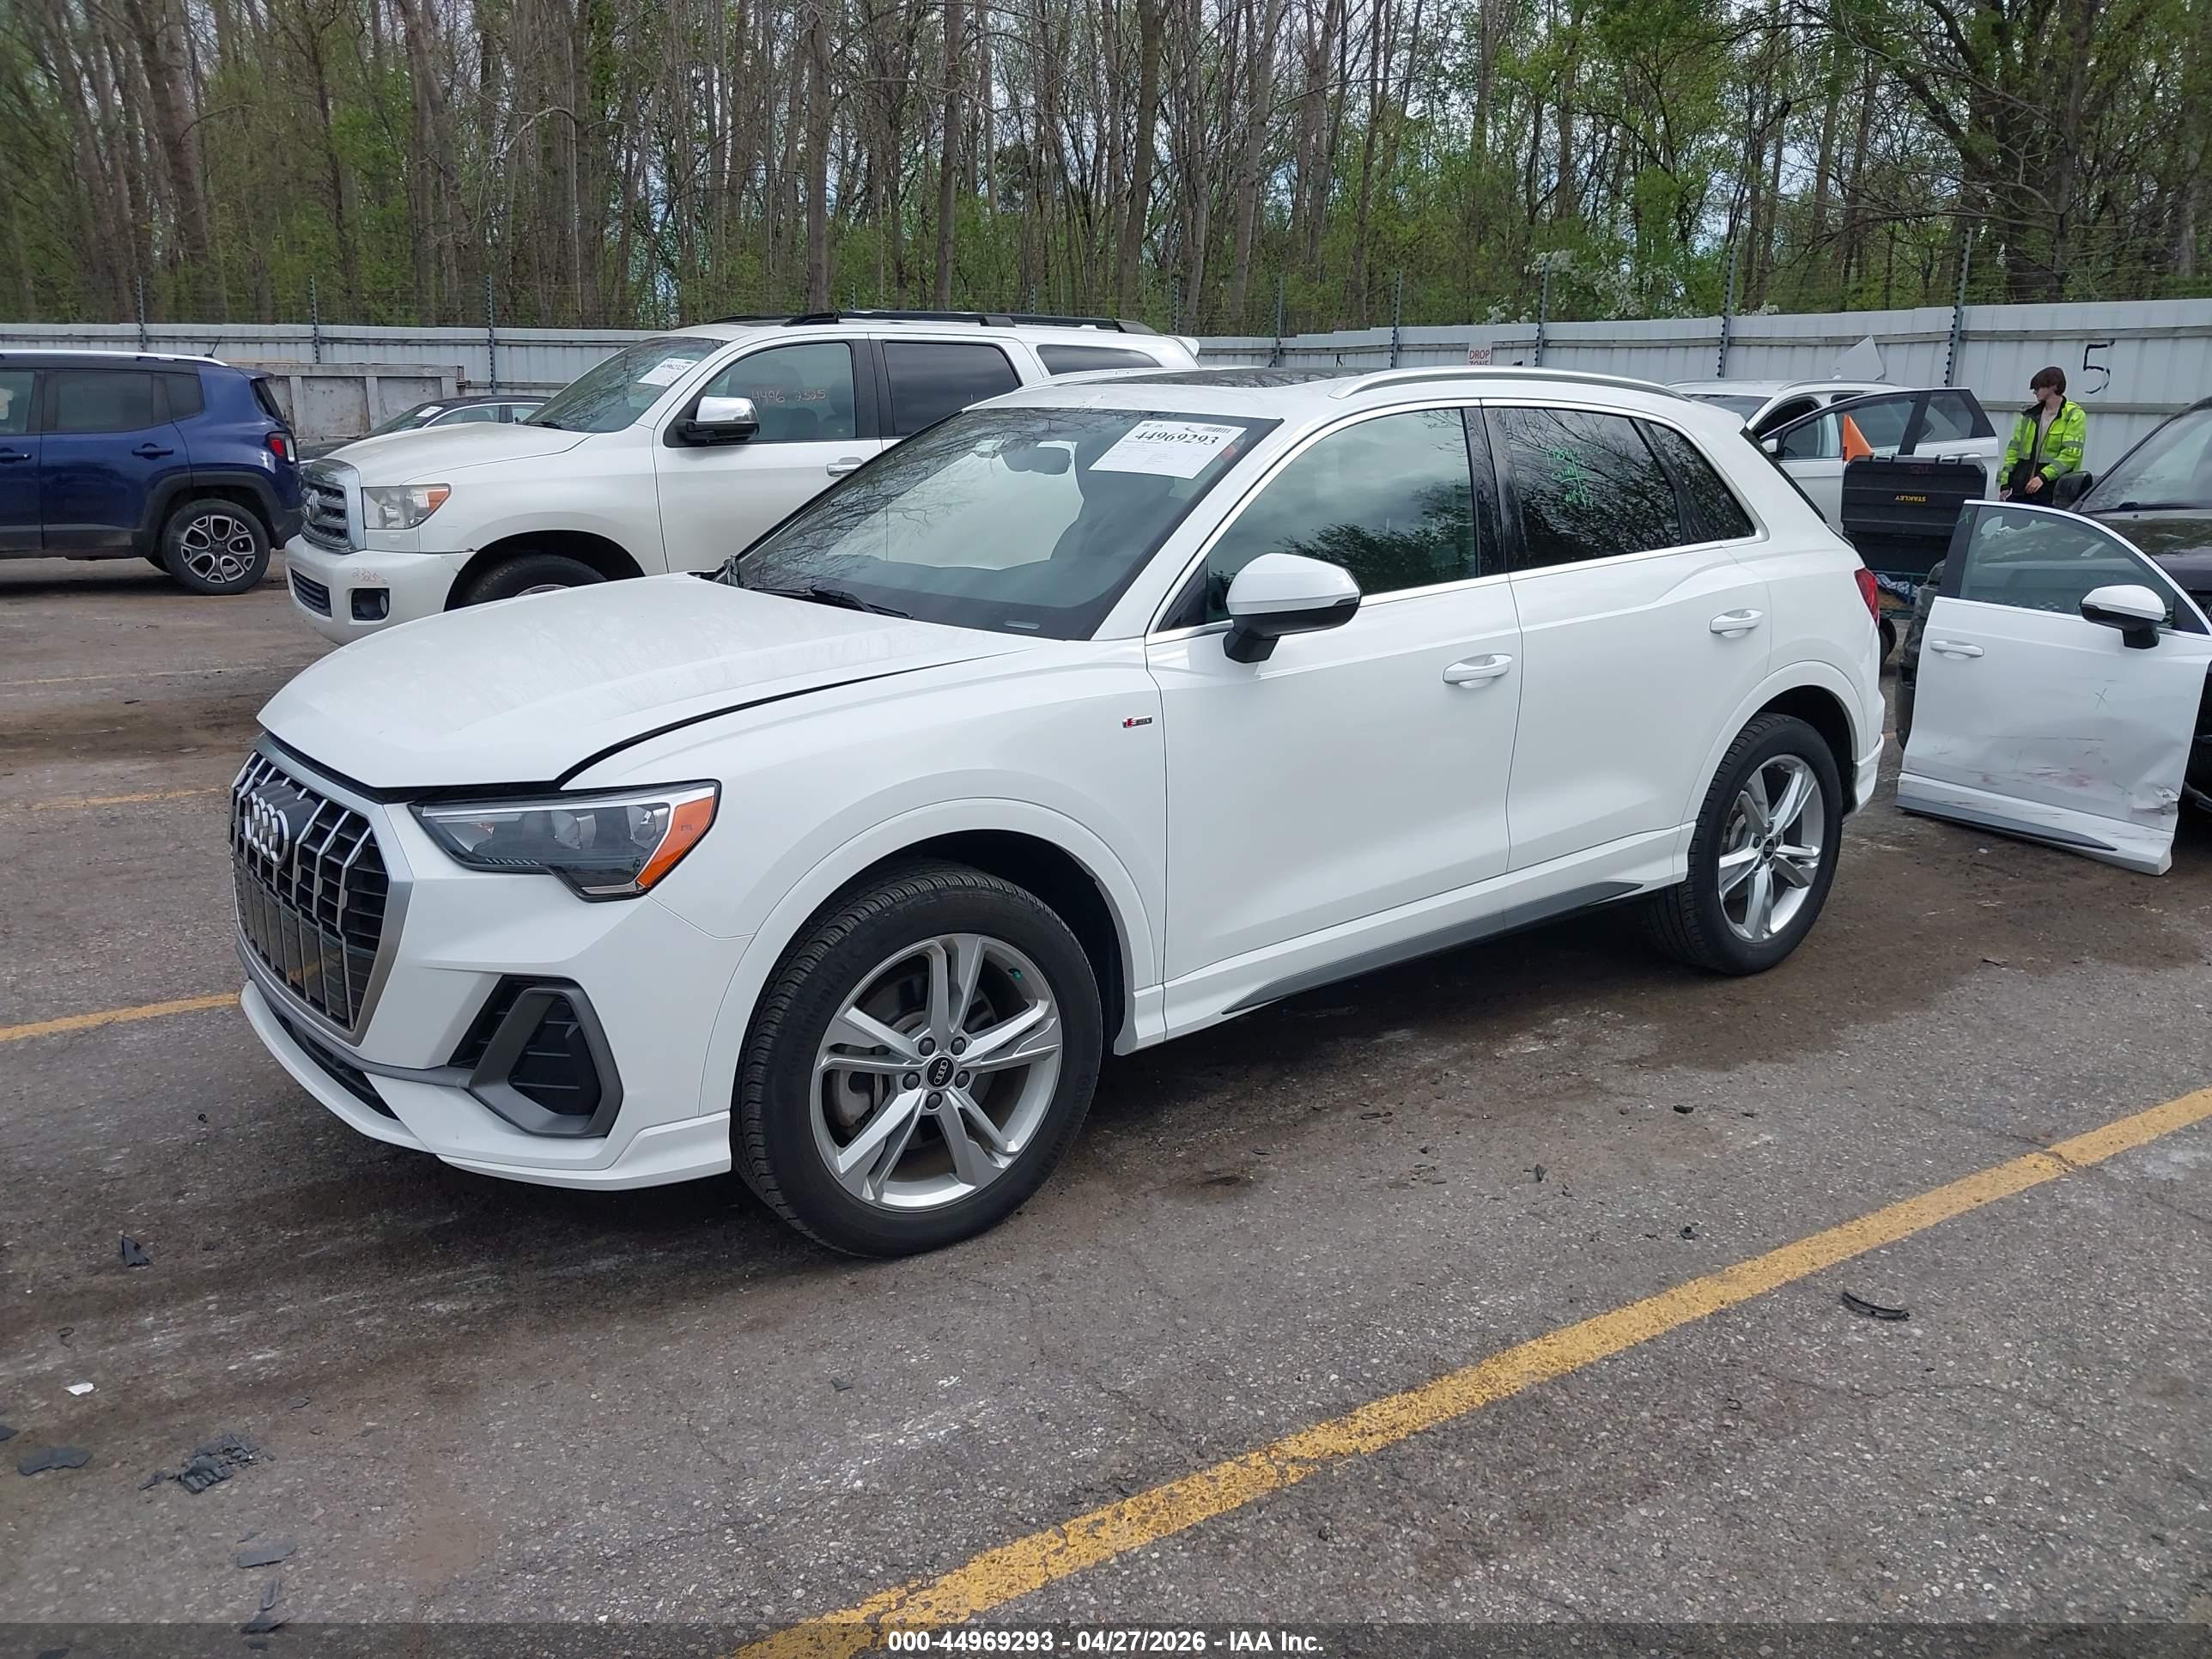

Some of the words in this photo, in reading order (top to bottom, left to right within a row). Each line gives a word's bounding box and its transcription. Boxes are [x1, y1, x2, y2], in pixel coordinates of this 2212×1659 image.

[1469, 349, 1490, 360] DROP
[2083, 340, 2116, 394] 5
[1135, 430, 1219, 446] 44969293
